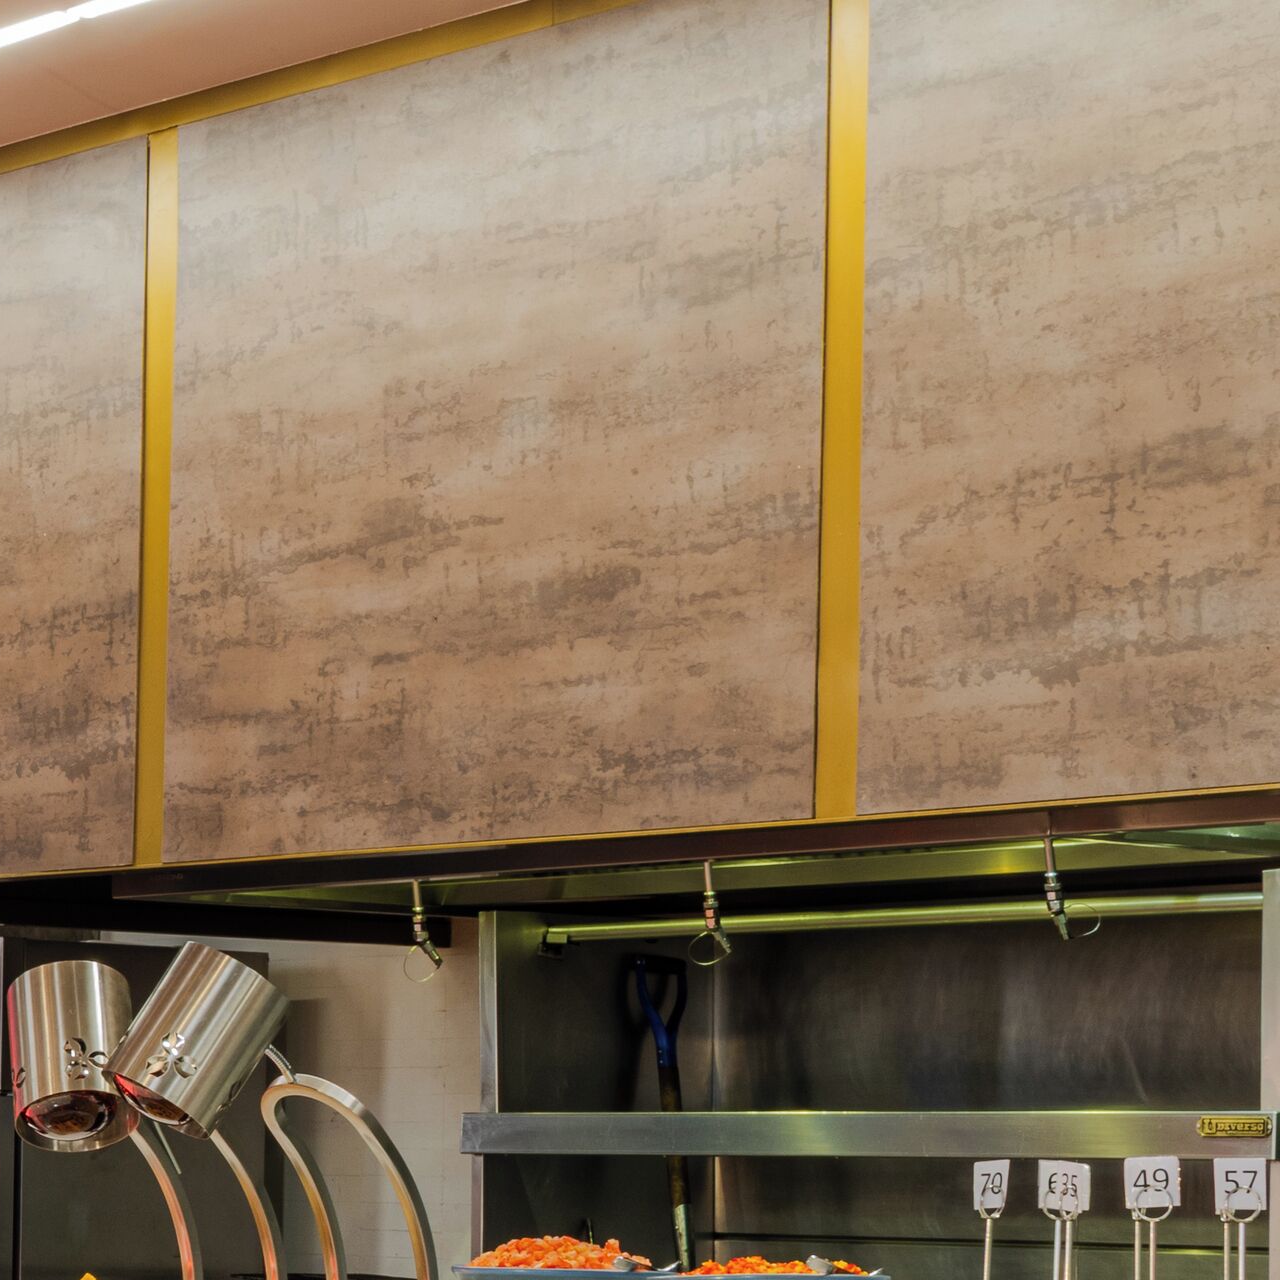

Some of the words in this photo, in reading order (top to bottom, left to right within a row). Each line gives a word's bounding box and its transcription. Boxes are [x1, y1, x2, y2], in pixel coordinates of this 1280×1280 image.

[980, 1172, 1003, 1194] 70
[1133, 1168, 1170, 1192] 49
[1224, 1170, 1258, 1194] 57
